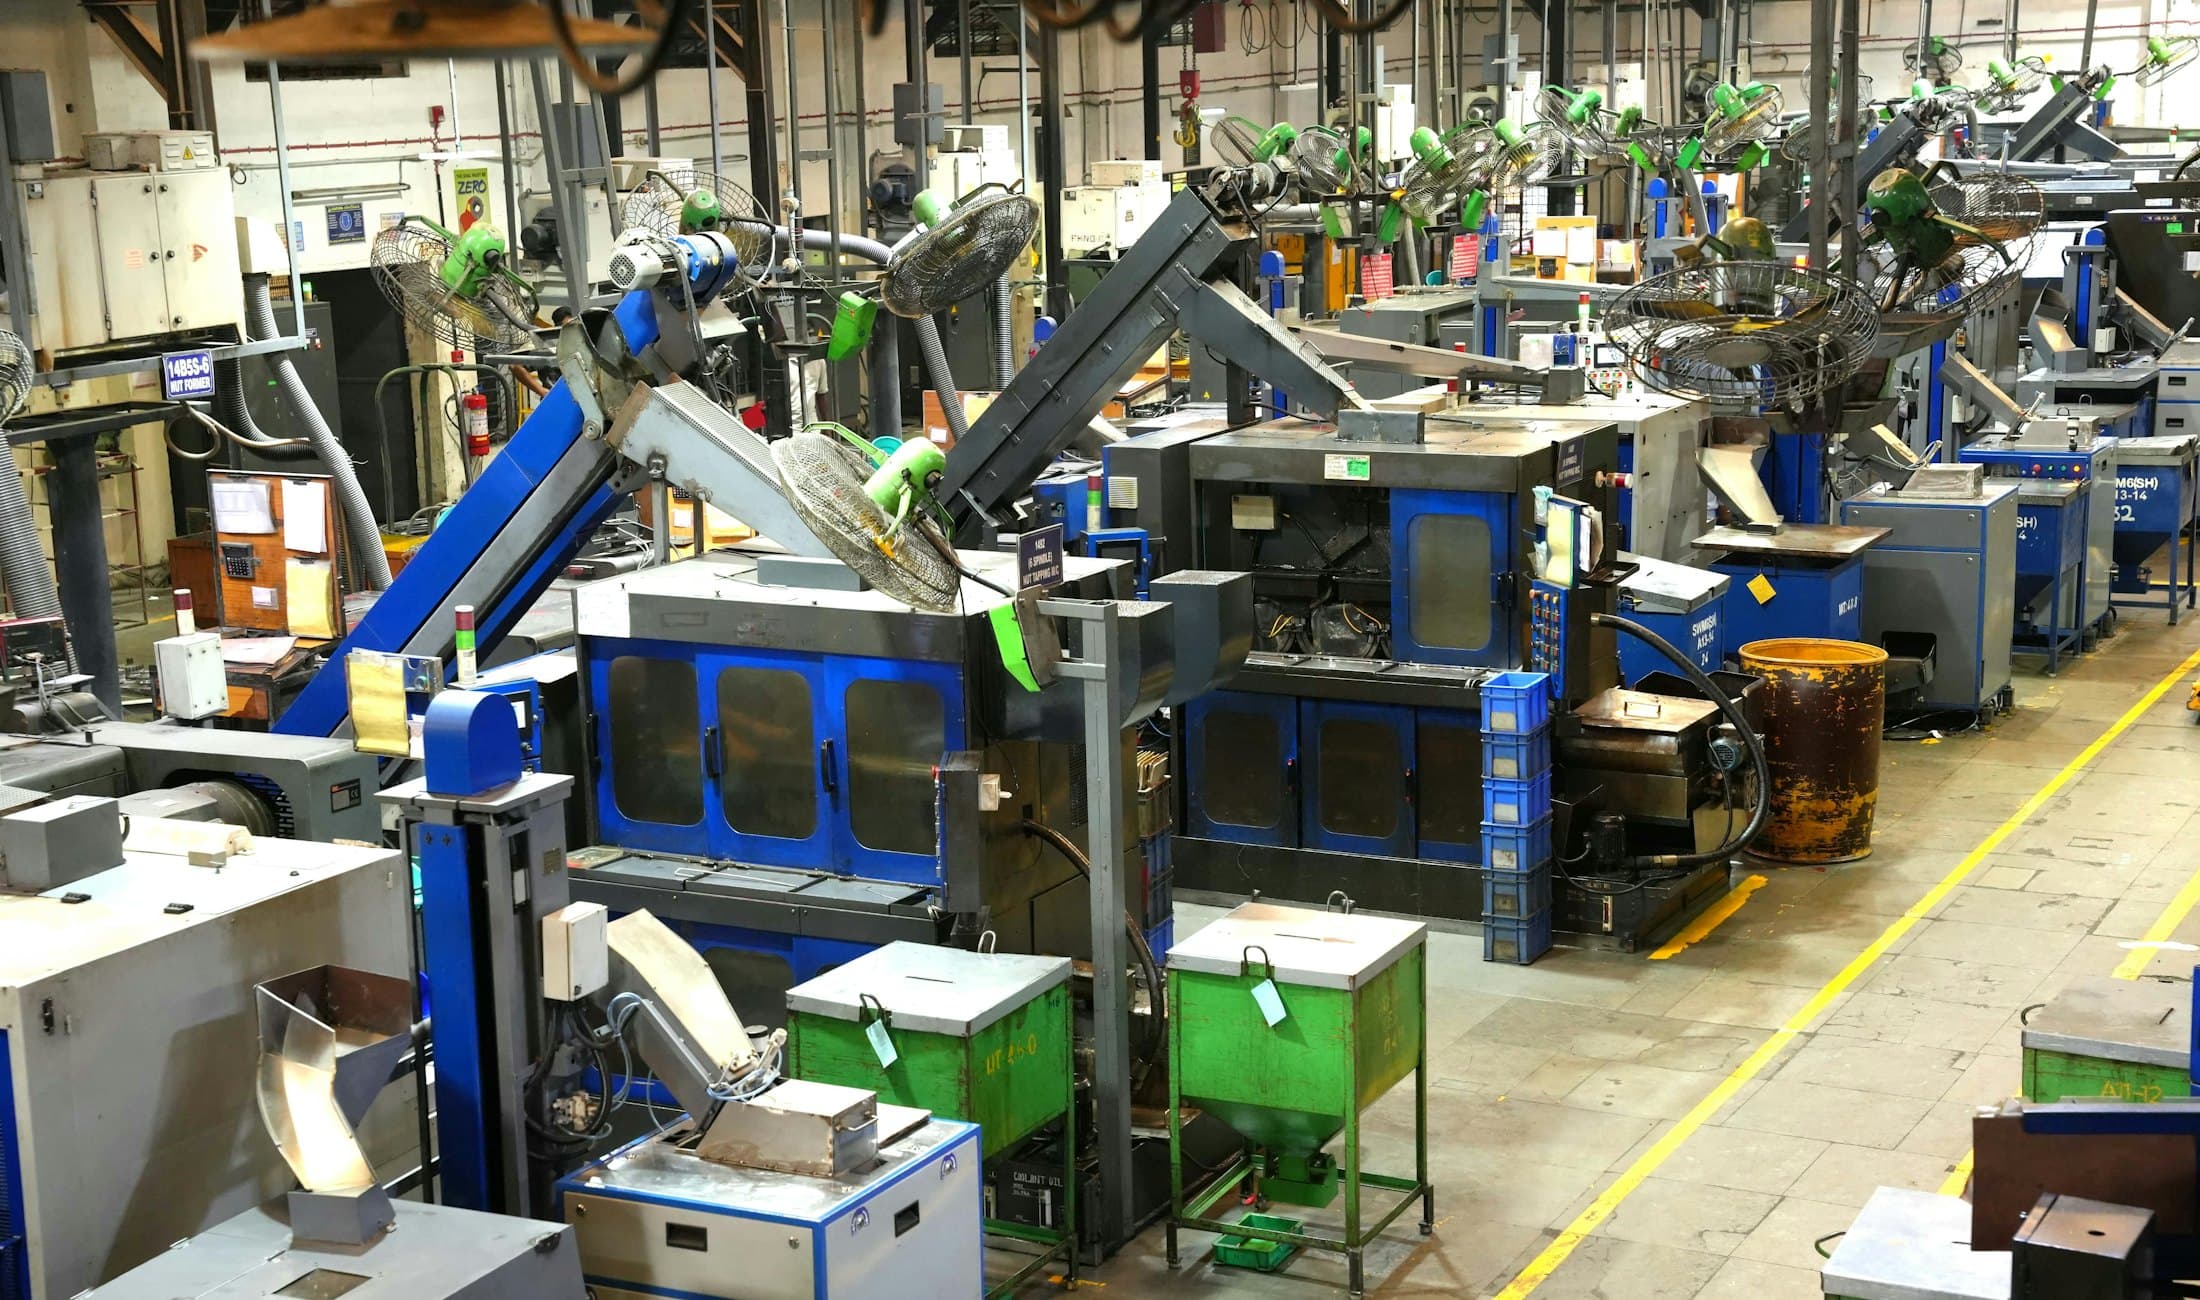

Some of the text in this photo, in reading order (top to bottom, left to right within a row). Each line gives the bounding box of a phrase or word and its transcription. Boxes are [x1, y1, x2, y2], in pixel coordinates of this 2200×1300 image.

[457, 179, 486, 194] ZERO
[170, 376, 211, 393] NUT FORMER
[1013, 1171, 1064, 1188] COOLANT OIL
